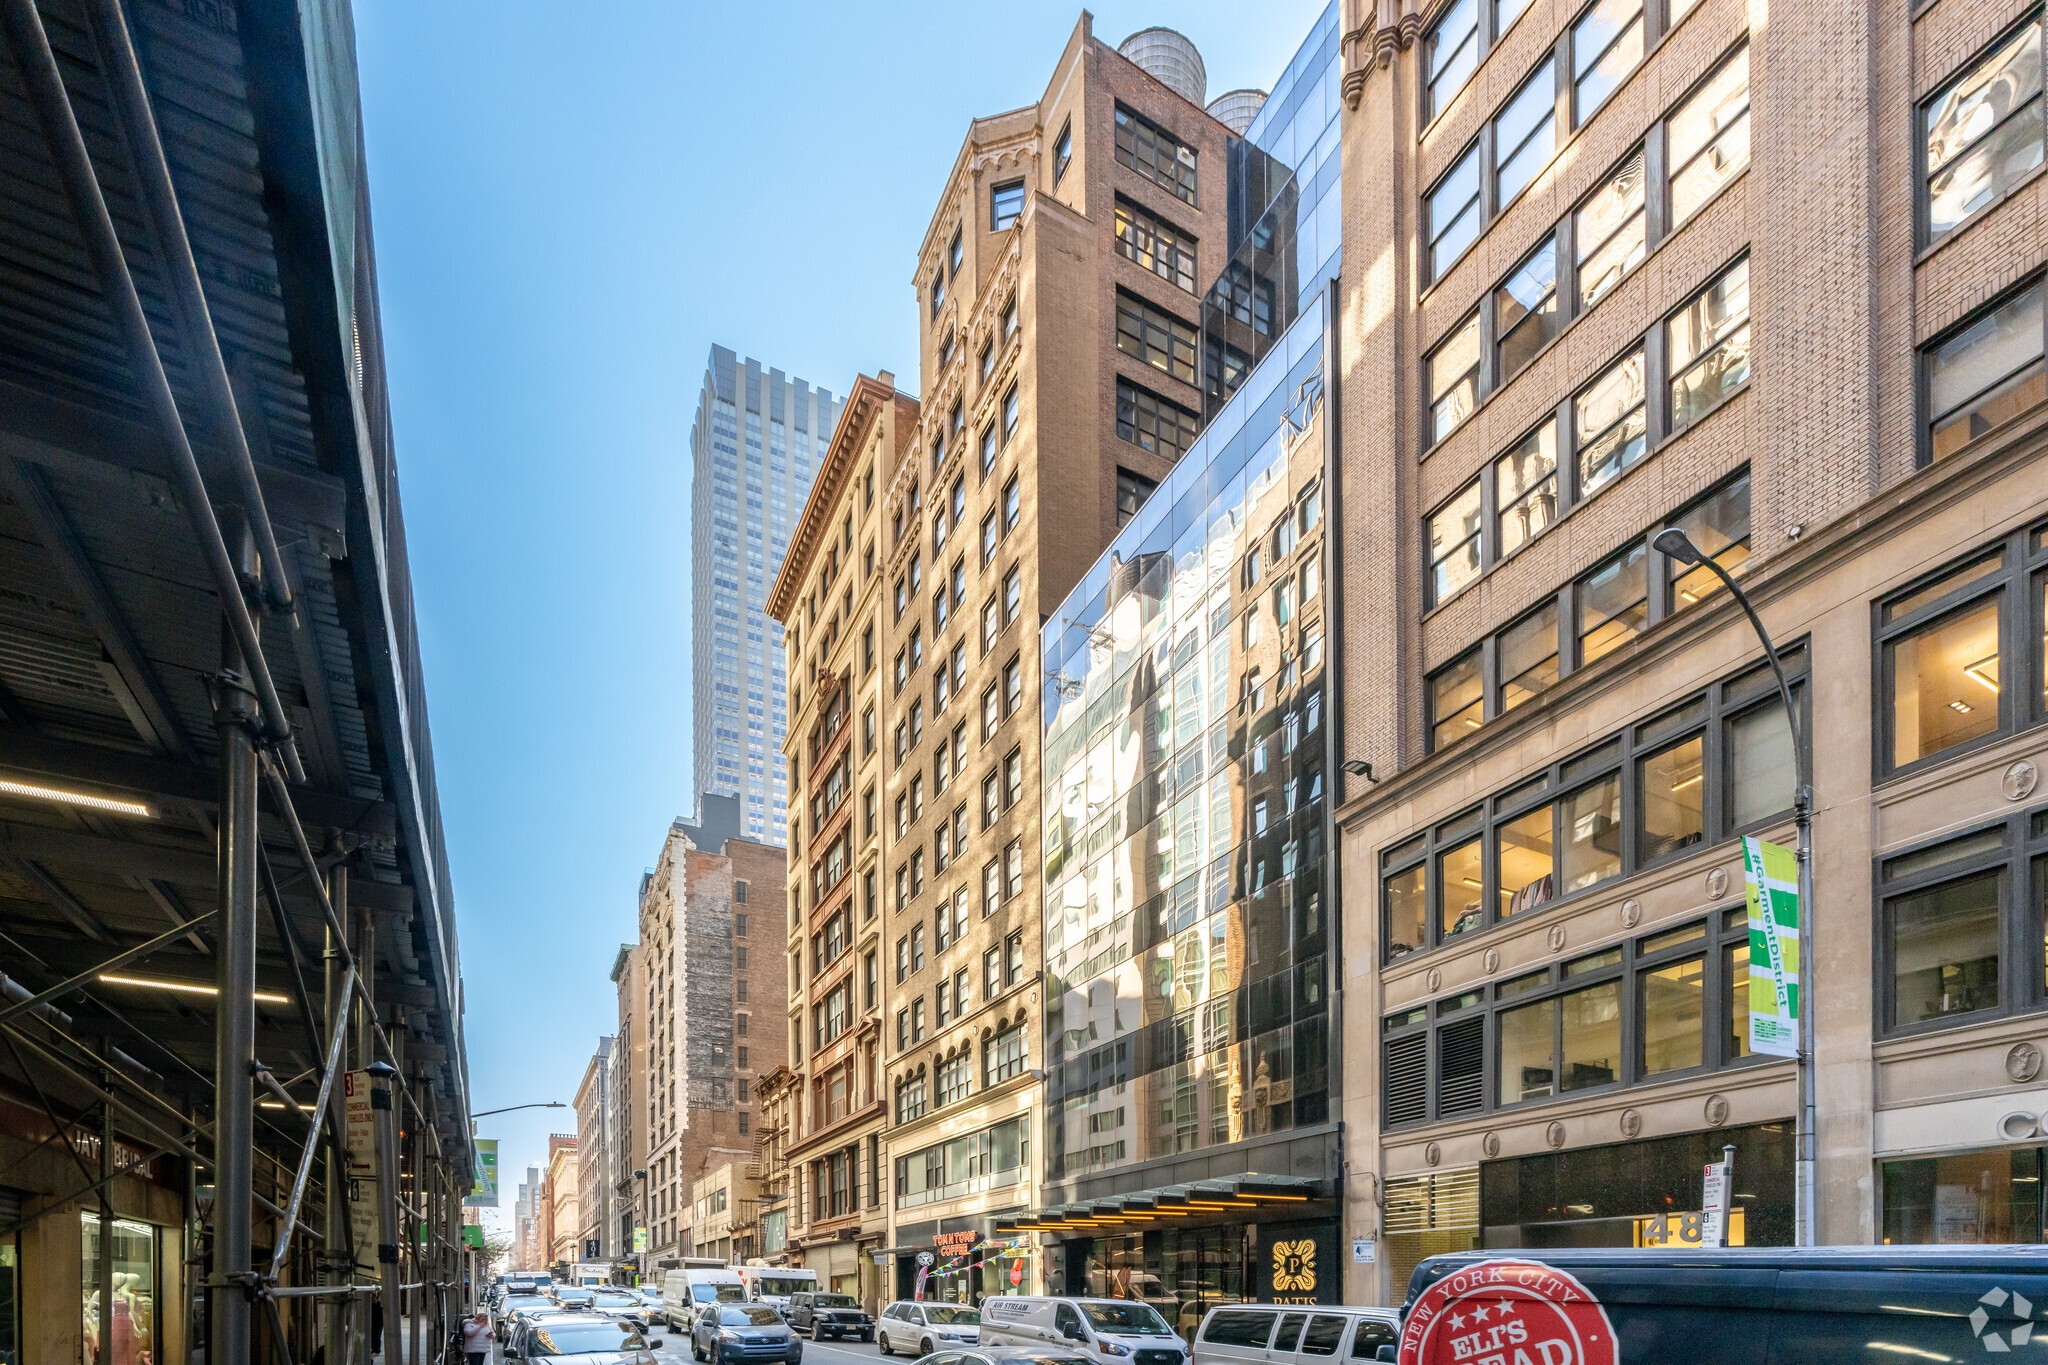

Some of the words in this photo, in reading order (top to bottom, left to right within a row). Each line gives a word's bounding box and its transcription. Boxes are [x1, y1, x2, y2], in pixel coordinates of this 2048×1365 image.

[1751, 853, 1788, 1008] #GarmentDistrict
[346, 1075, 352, 1095] 3
[1996, 1110, 2048, 1140] C
[352, 1181, 358, 1200] 6
[1643, 1211, 1702, 1244] 48
[941, 1243, 968, 1257] COFFEE
[1289, 1257, 1300, 1273] P
[1004, 1302, 1029, 1311] STREAM
[1404, 1301, 1434, 1353] NEW
[1436, 1266, 1506, 1300] YORK
[1518, 1269, 1581, 1307] CITY
[1449, 1319, 1528, 1361] ELI'S
